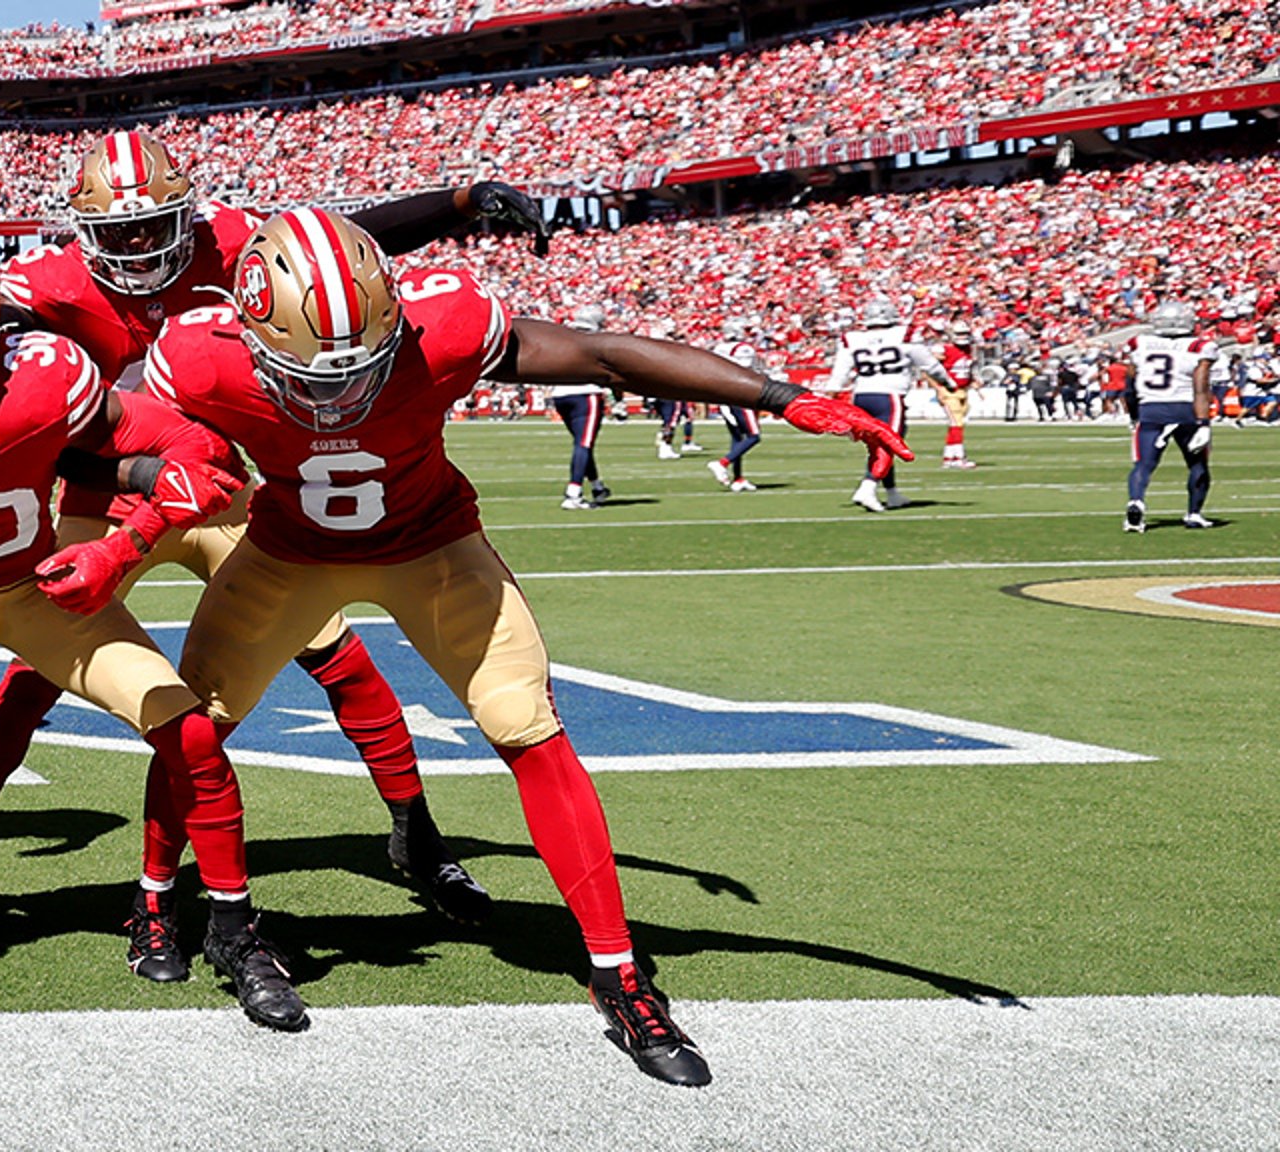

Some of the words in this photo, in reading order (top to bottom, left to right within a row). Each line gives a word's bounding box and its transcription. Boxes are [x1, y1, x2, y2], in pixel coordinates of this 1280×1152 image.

[853, 346, 908, 376] 62
[1144, 353, 1174, 390] 3
[297, 451, 387, 531] 6
